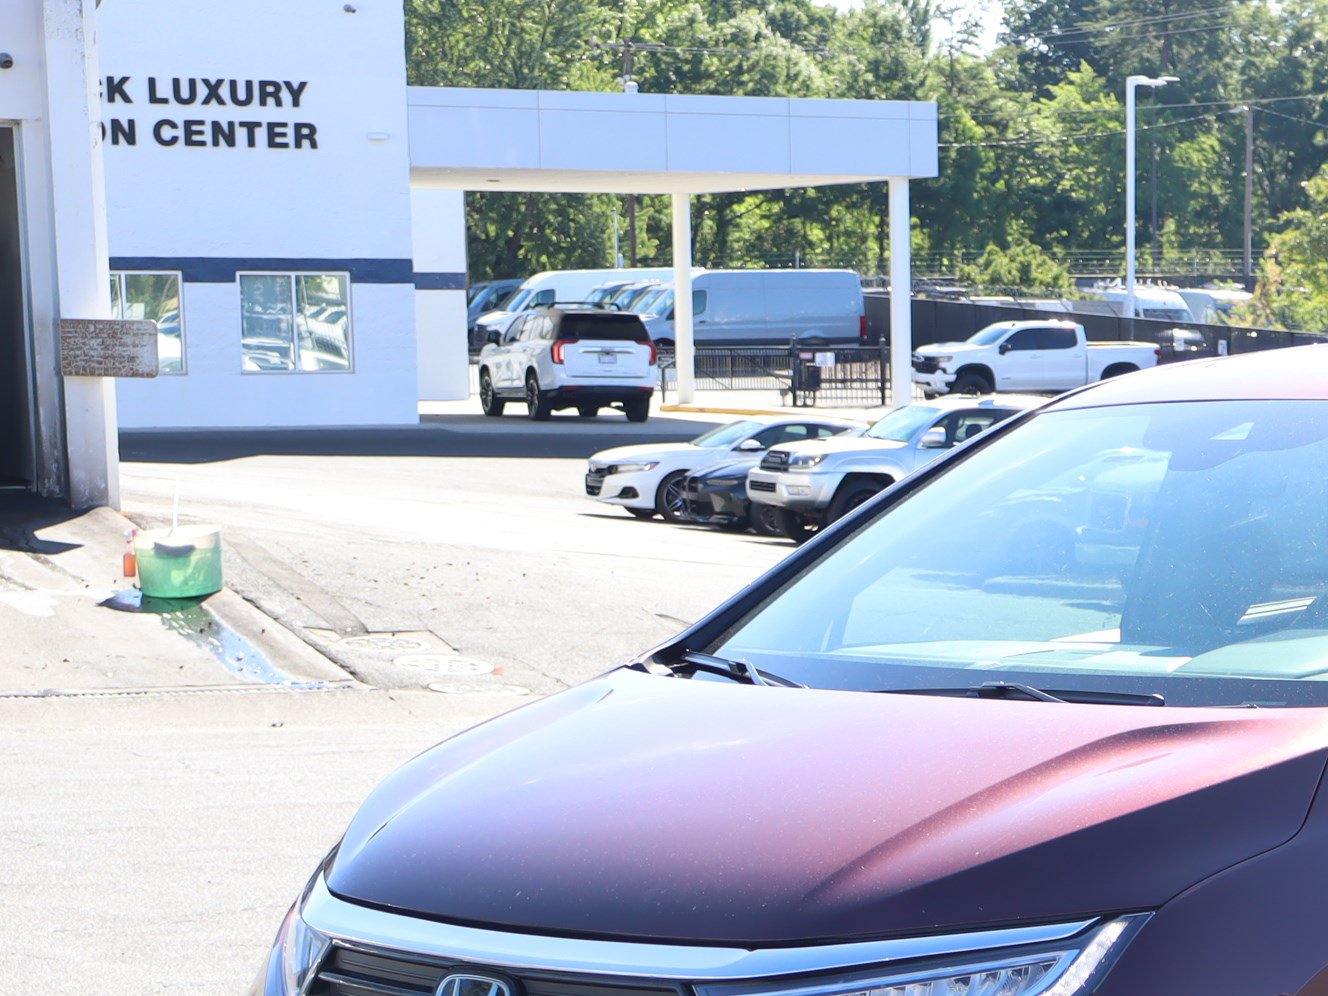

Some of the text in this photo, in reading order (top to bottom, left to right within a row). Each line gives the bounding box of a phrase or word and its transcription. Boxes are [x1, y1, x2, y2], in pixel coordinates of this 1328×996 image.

[99, 76, 308, 107] K LUXURY
[99, 118, 318, 149] N CENTER
